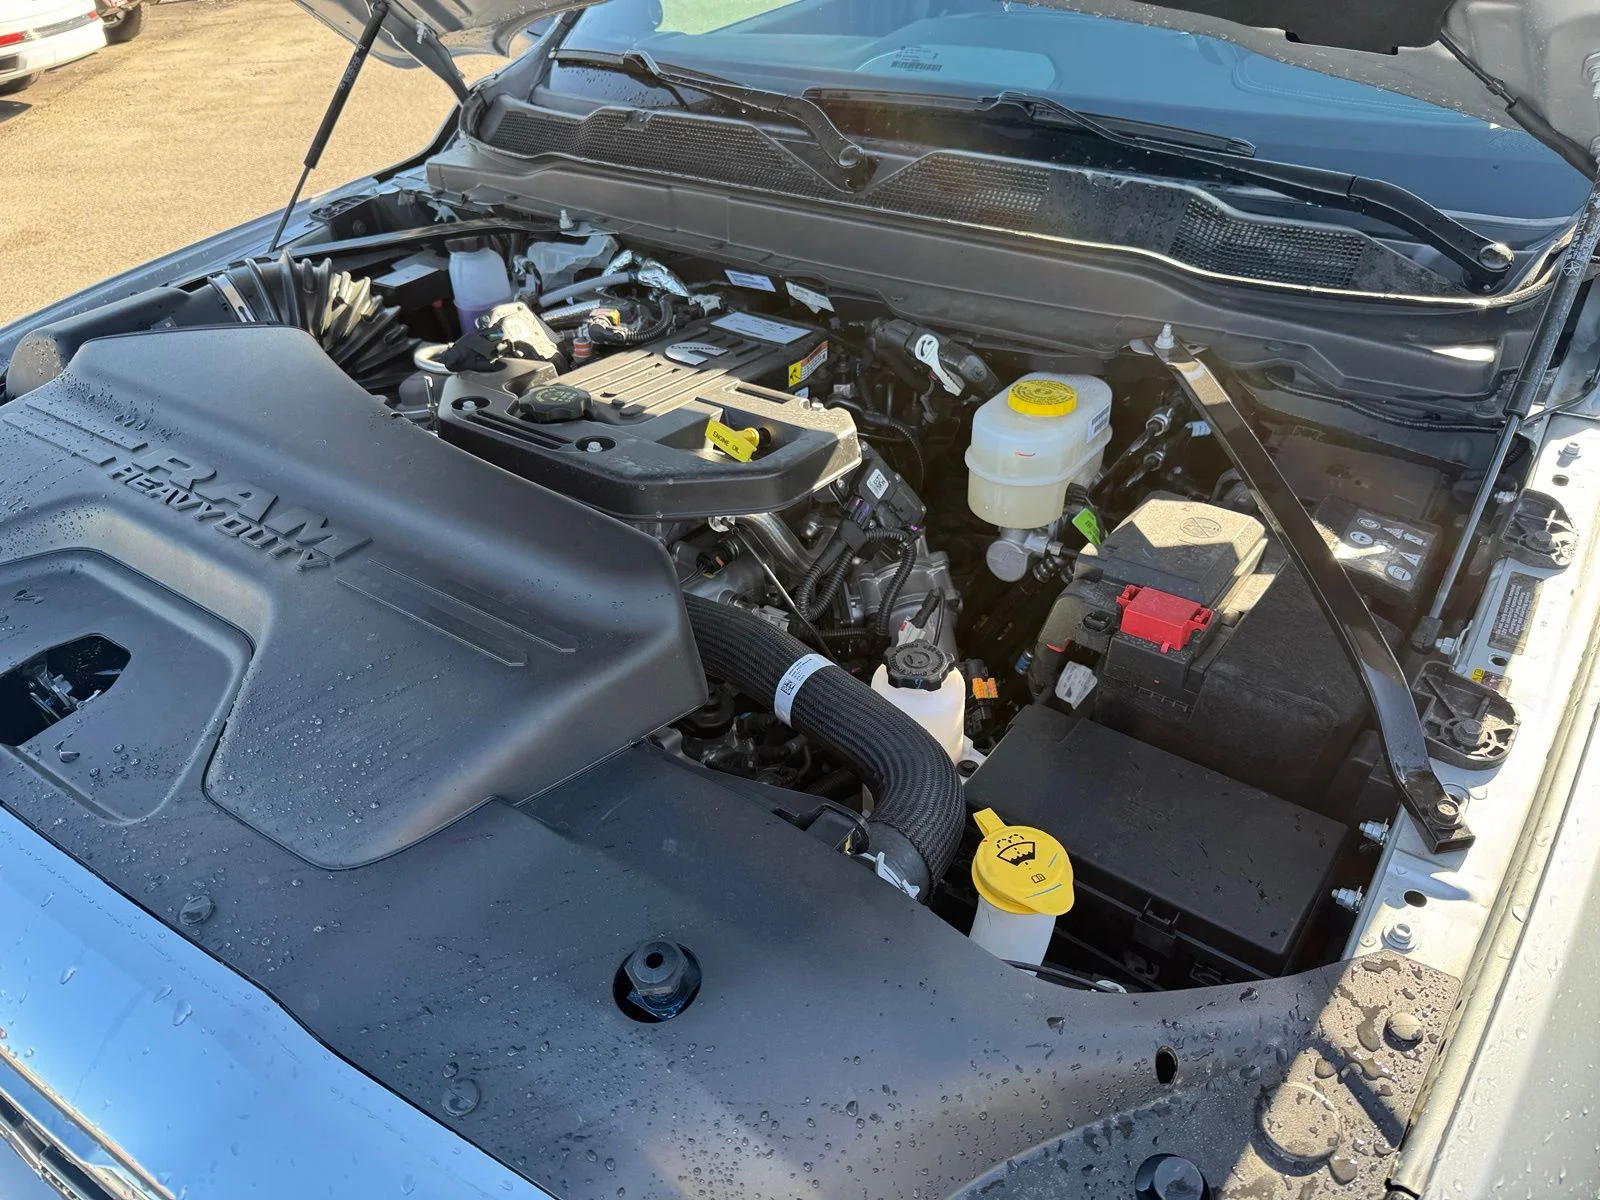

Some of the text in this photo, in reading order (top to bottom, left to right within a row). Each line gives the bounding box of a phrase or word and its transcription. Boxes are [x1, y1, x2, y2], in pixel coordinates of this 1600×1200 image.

[713, 430, 740, 455] ENGINE OIL
[107, 465, 331, 573] HEAVY DUTY
[131, 449, 373, 561] RAM
